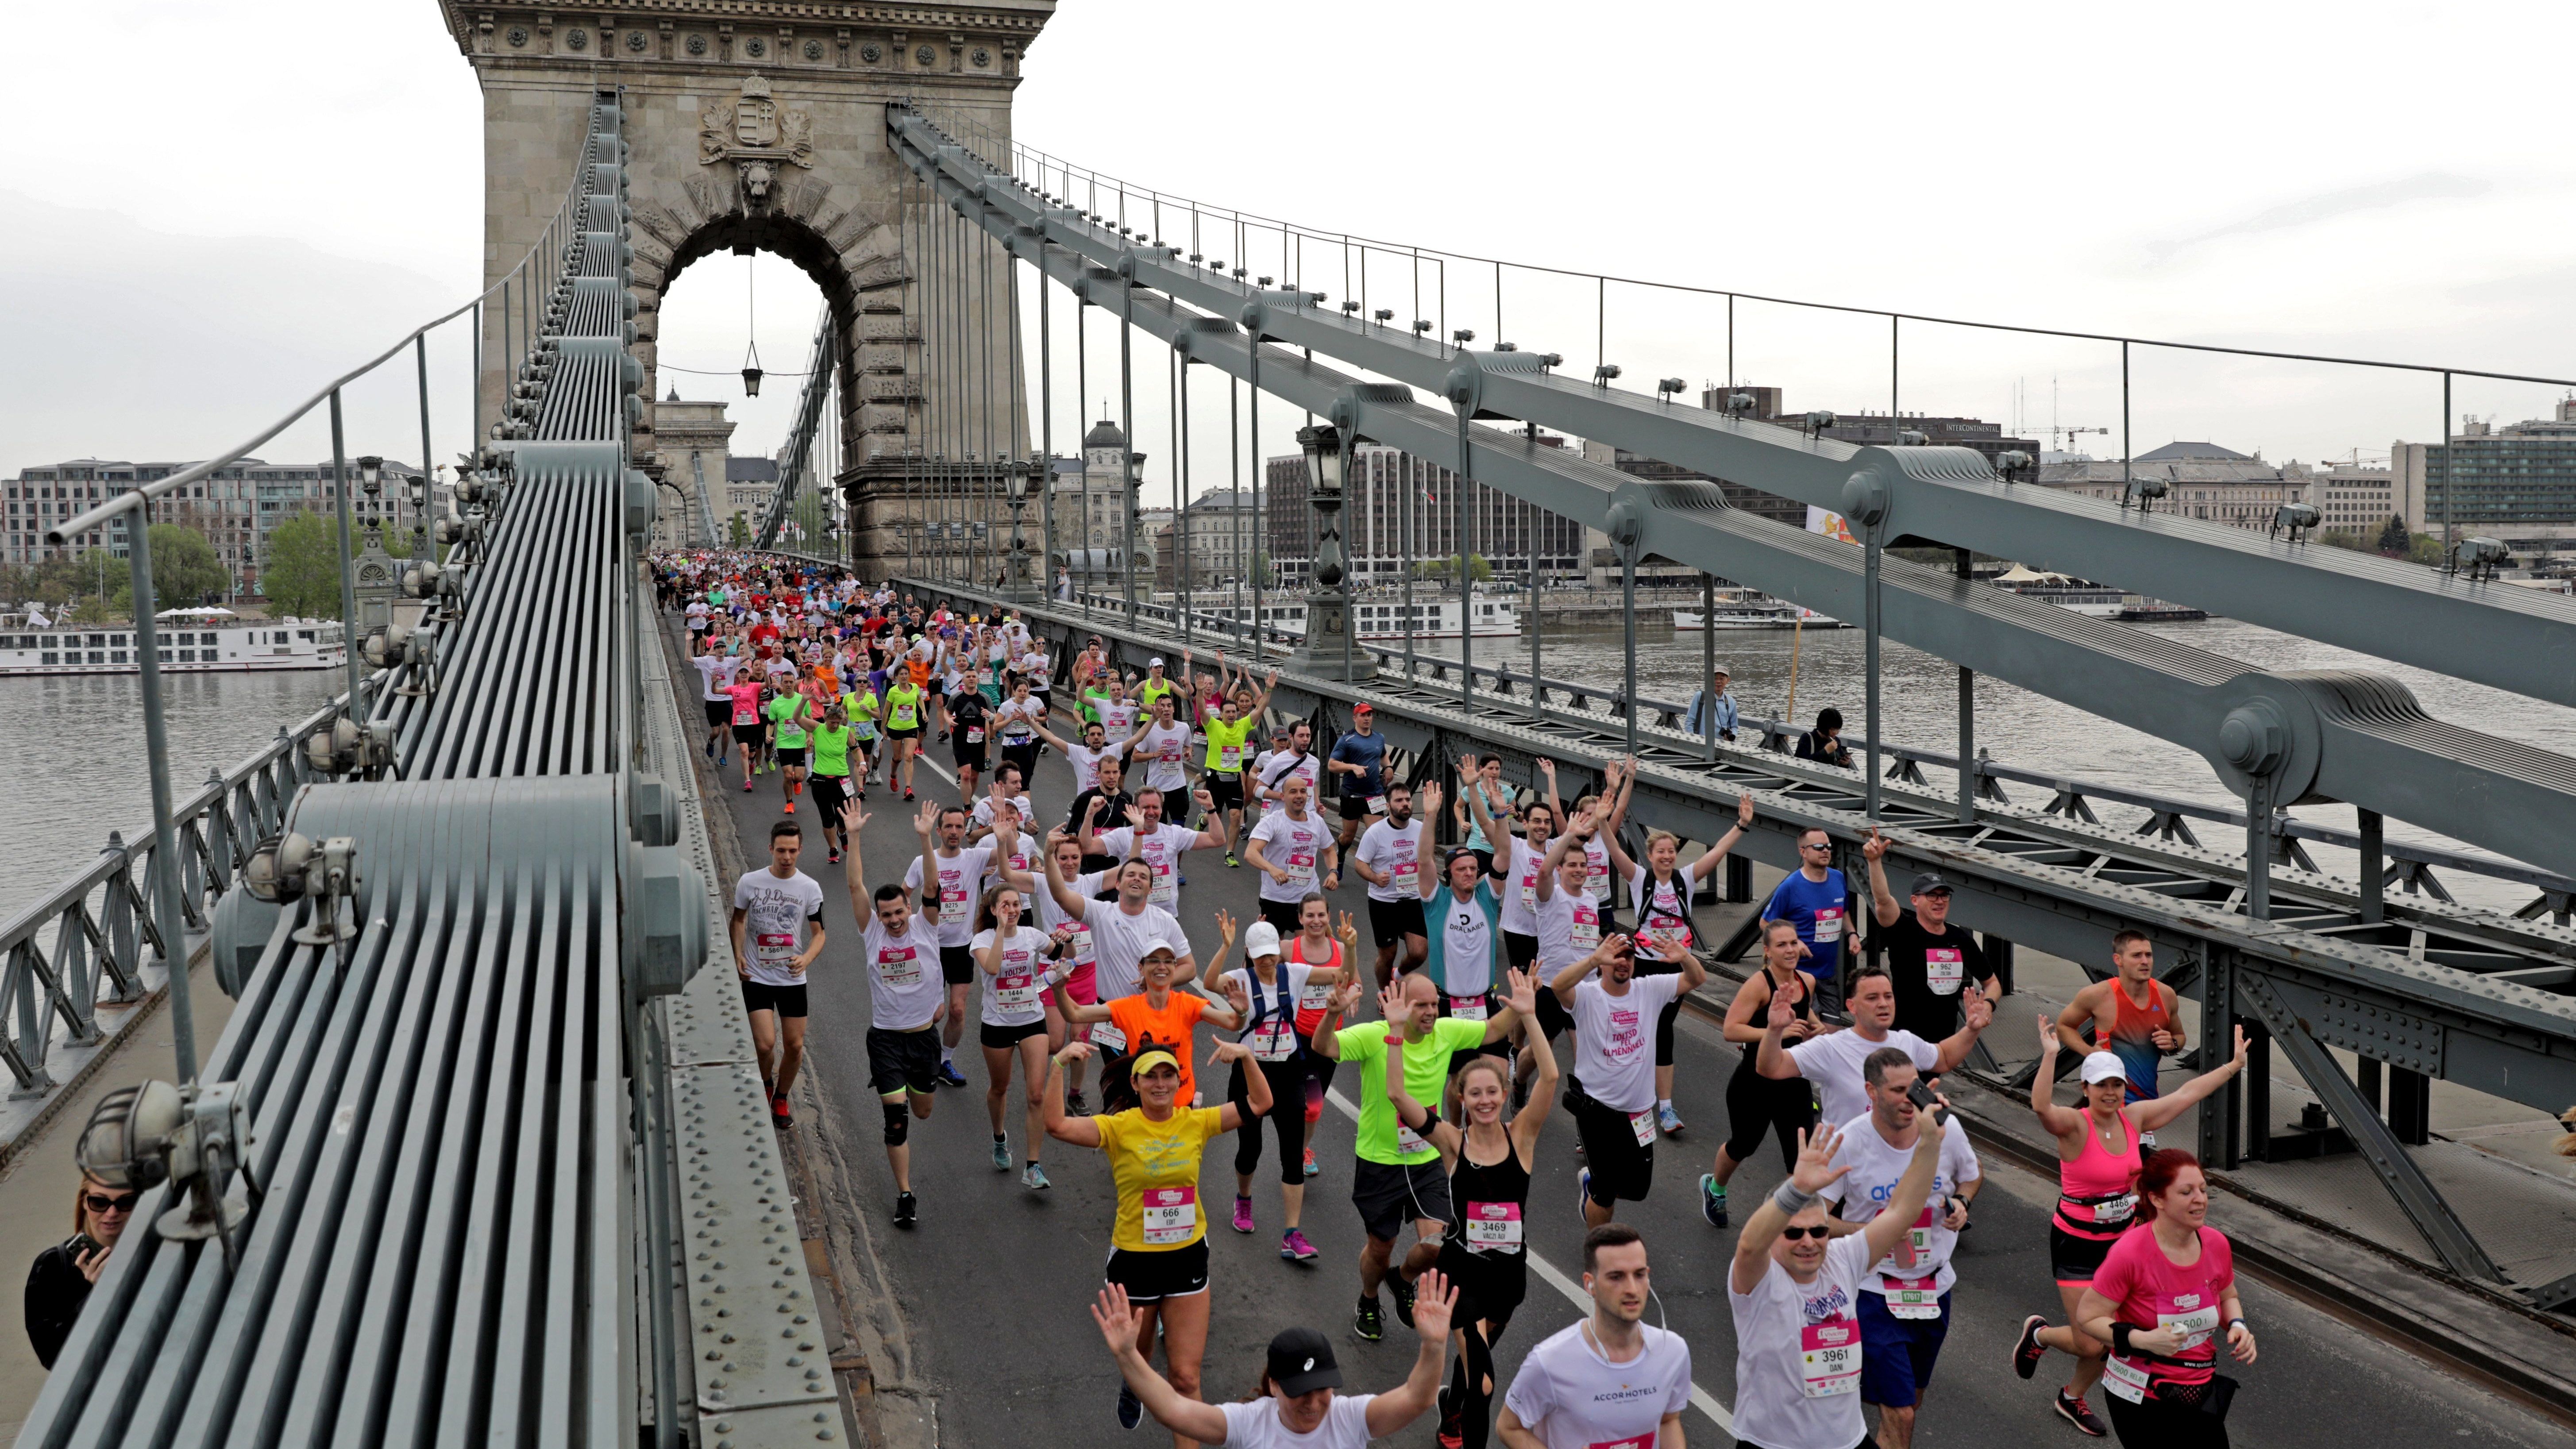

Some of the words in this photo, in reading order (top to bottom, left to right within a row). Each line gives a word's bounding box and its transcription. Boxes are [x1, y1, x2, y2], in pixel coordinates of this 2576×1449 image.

[1871, 1175, 1942, 1201] ads
[2109, 1199, 2129, 1209] 4468
[1162, 1208, 1179, 1217] 666
[1482, 1222, 1506, 1232] 3469
[1904, 1292, 1920, 1302] 17617
[1822, 1350, 1849, 1362] 3961
[1829, 1364, 1843, 1372] DANI
[2129, 1372, 2144, 1383] RELAY
